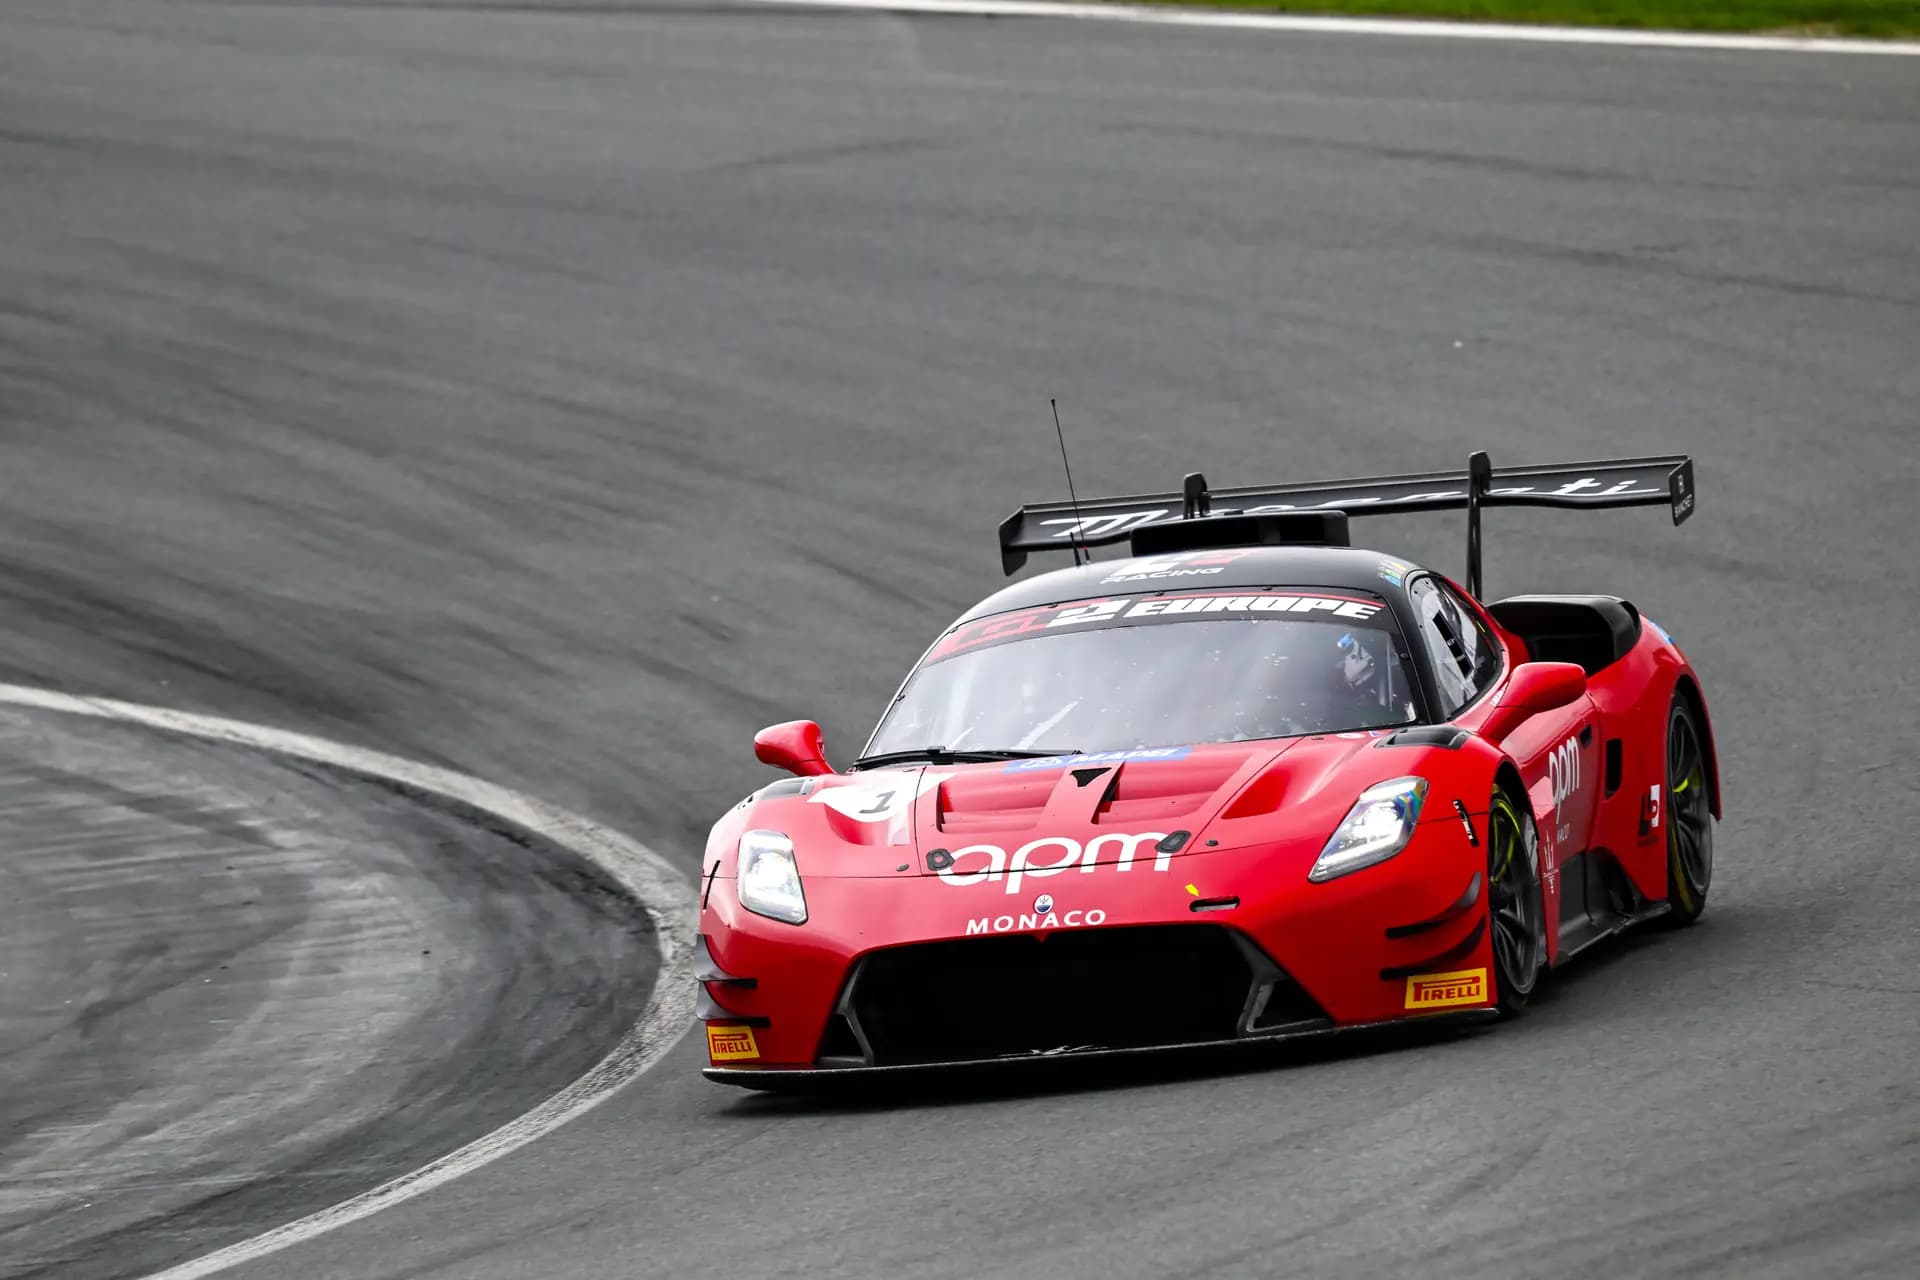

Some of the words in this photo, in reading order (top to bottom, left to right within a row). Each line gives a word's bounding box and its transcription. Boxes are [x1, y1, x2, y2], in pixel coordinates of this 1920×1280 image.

[1099, 567, 1225, 585] RACING
[1122, 596, 1382, 620] EUROPE
[857, 789, 897, 815] 1
[938, 831, 1173, 894] apm
[965, 908, 1107, 936] MONACO
[1413, 975, 1481, 1002] PIRELLI
[711, 1033, 753, 1054] PIRELLI
